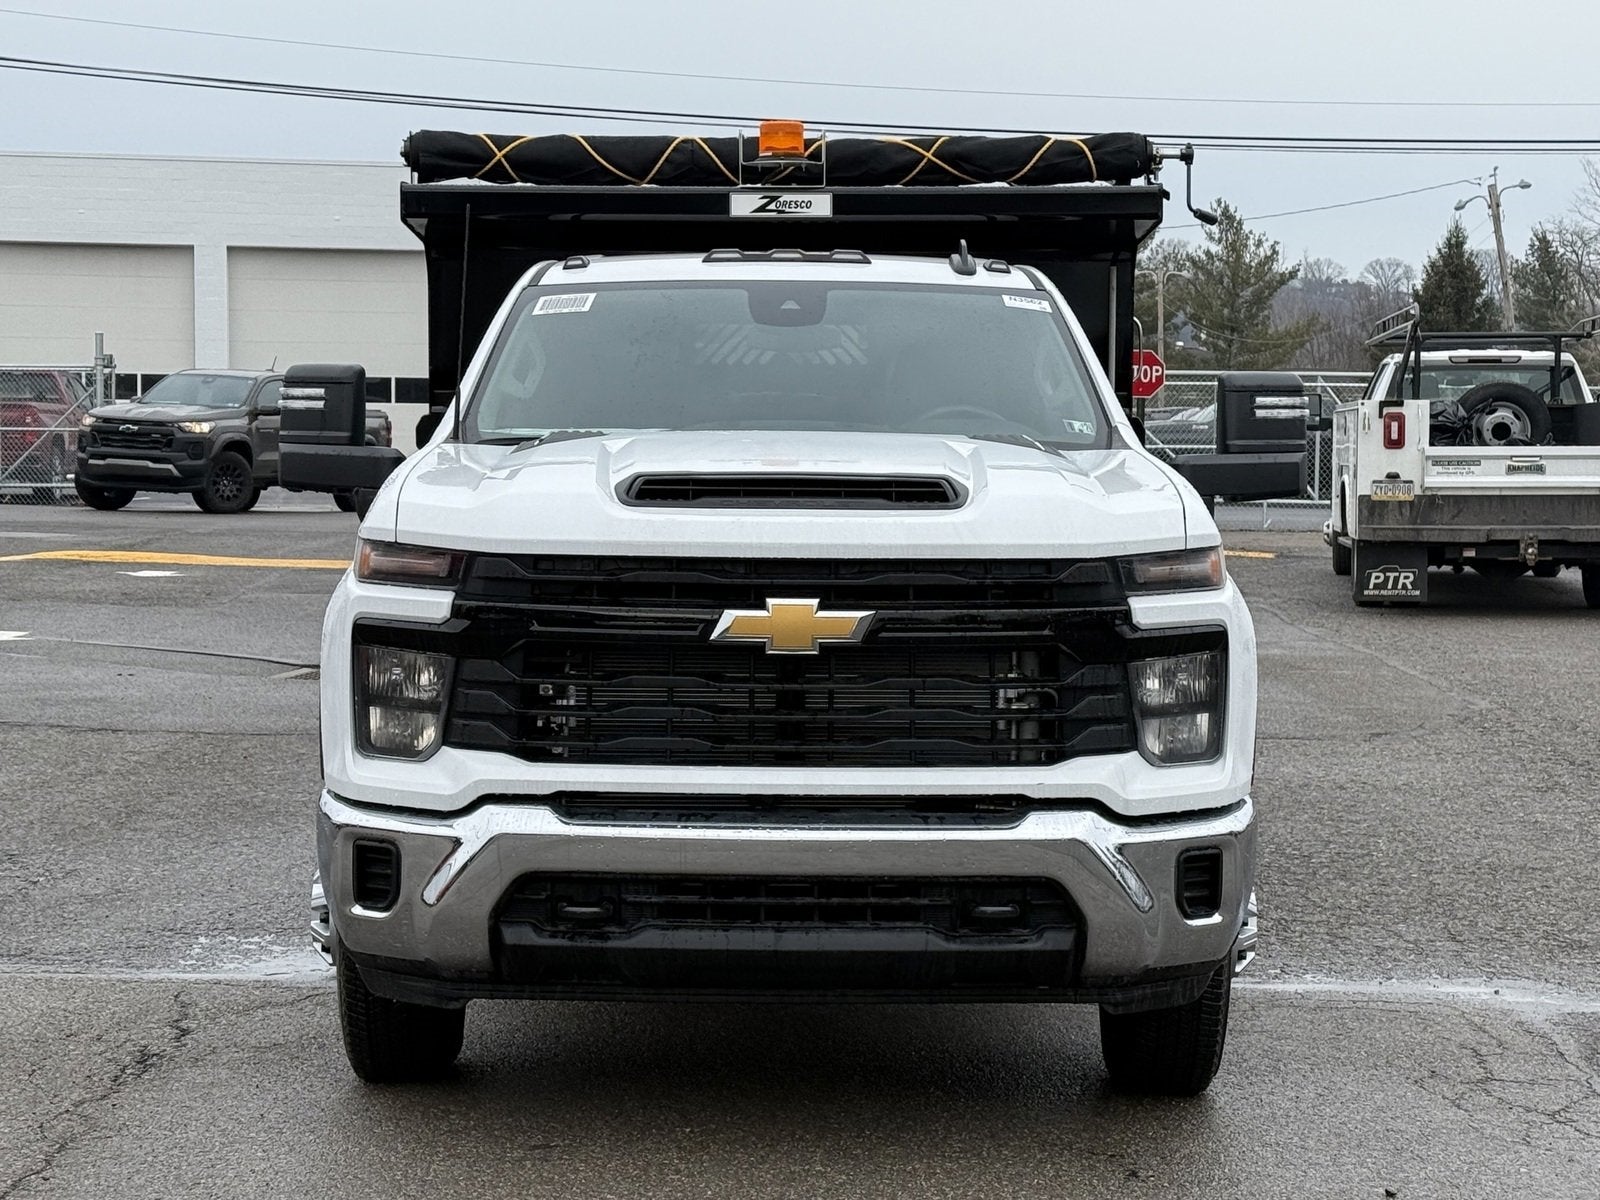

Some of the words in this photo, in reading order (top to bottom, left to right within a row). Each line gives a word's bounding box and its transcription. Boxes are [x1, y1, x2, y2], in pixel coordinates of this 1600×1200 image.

[749, 195, 813, 214] ZORESCO
[1132, 365, 1163, 383] TOP
[1507, 463, 1545, 473] KNAPHEIDE
[1368, 572, 1415, 590] PTR
